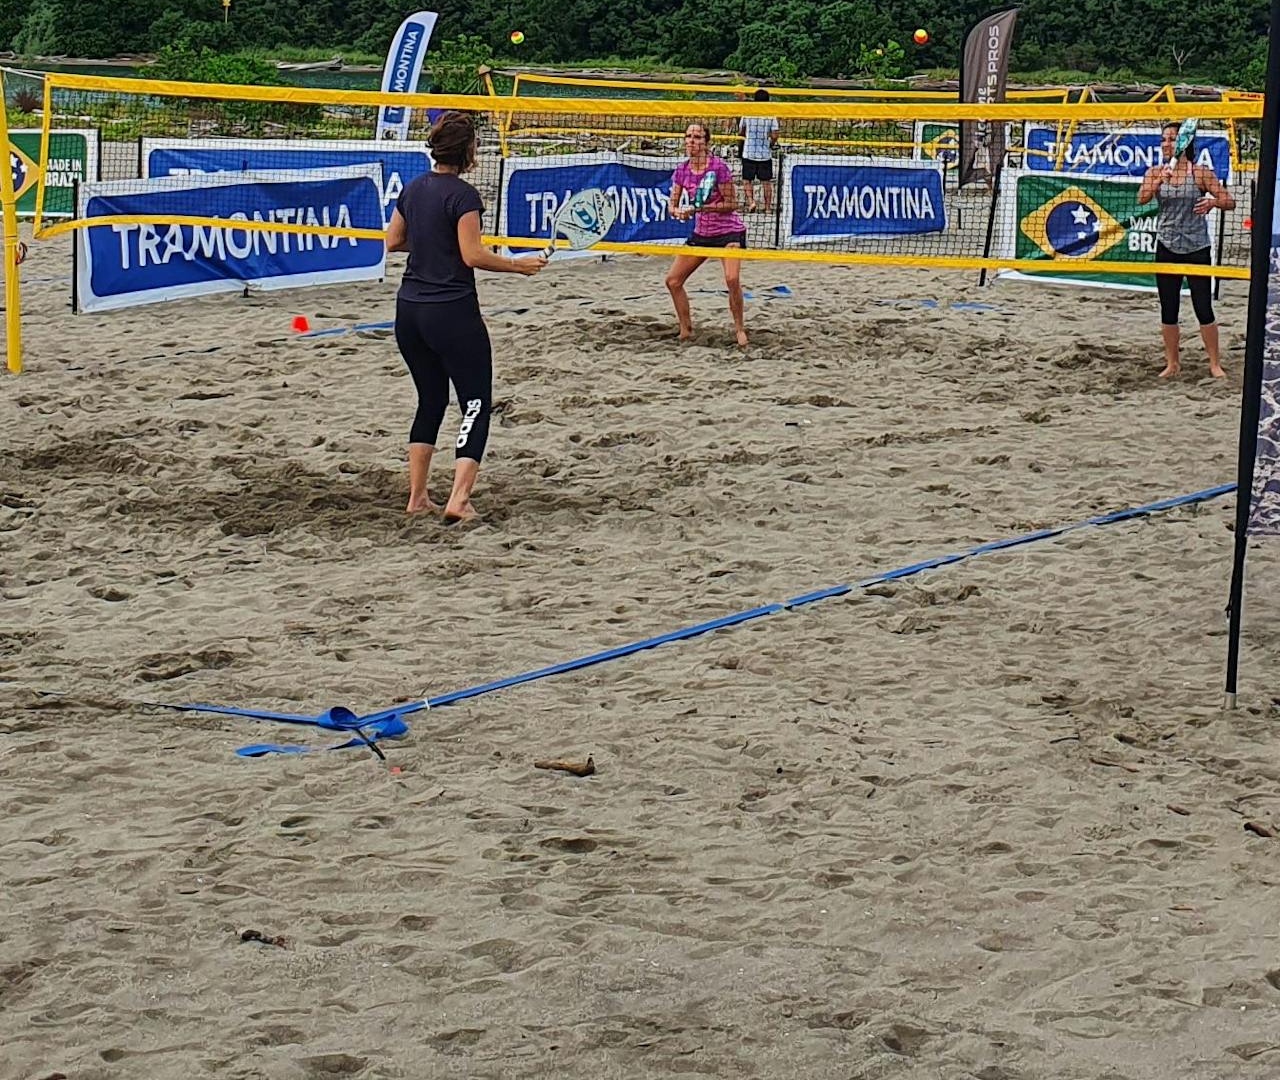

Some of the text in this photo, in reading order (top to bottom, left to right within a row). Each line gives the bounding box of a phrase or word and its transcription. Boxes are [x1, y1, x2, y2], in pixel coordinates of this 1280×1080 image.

[388, 30, 419, 116] TMONTINA
[804, 185, 935, 219] TRAMONTINA
[112, 204, 358, 270] TRAMONTINA
